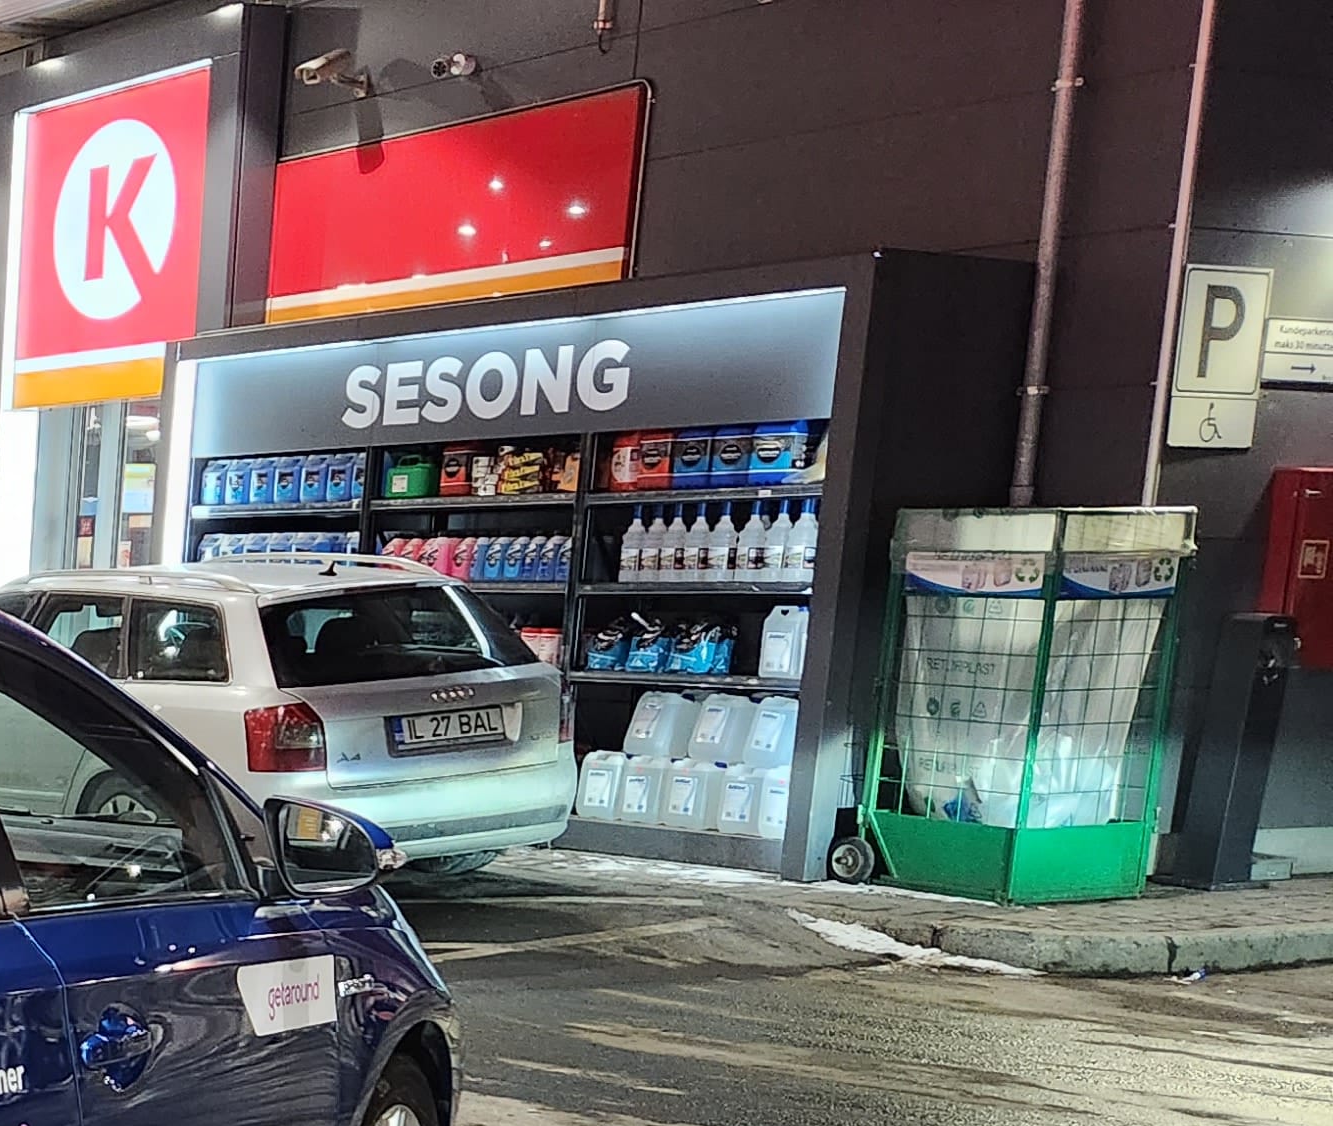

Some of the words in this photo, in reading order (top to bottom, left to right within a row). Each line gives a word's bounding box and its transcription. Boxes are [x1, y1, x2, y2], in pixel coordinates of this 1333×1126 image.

[1197, 283, 1246, 378] P
[1279, 325, 1333, 337] Kundeparkerin
[340, 339, 631, 429] SESONG
[429, 713, 452, 738] 27
[458, 711, 499, 735] BAL
[267, 974, 321, 1021] getaround
